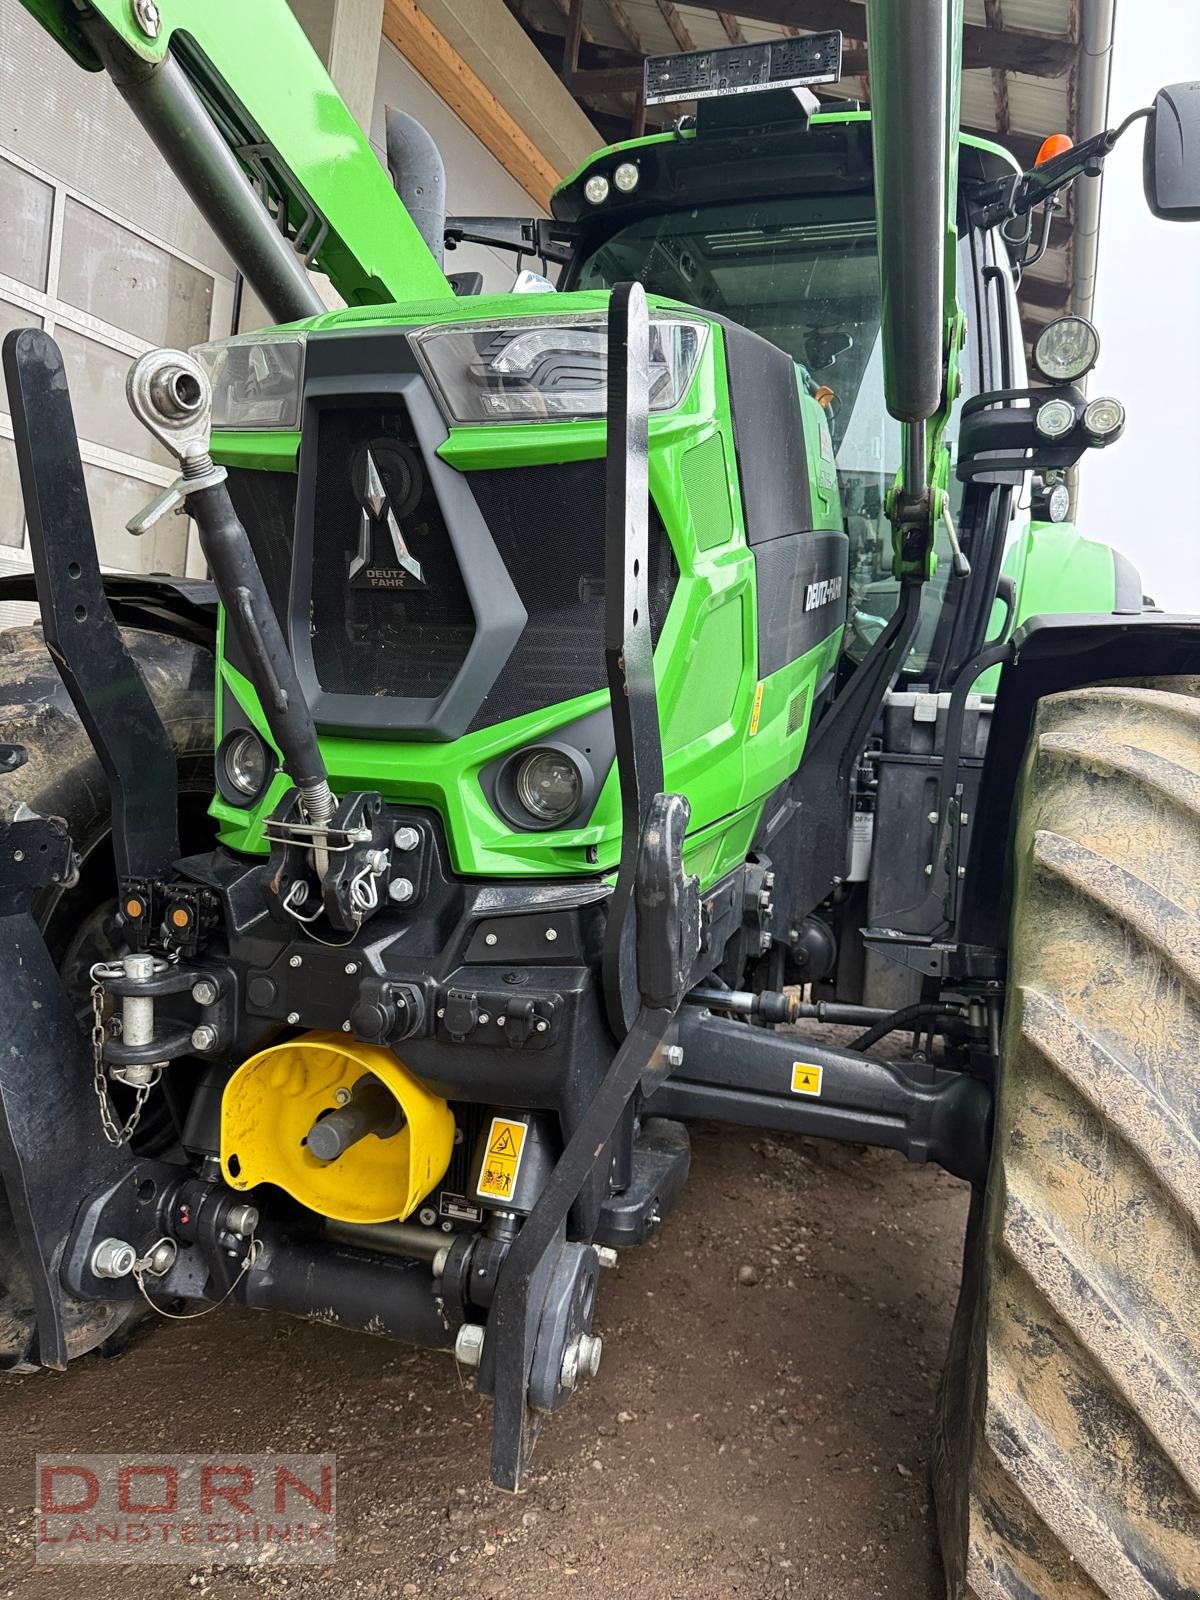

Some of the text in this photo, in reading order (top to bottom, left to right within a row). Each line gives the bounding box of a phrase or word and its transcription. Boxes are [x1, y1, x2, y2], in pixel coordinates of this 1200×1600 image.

[716, 87, 738, 95] DORN
[366, 570, 407, 578] DEUTZ
[371, 579, 404, 587] FAHR
